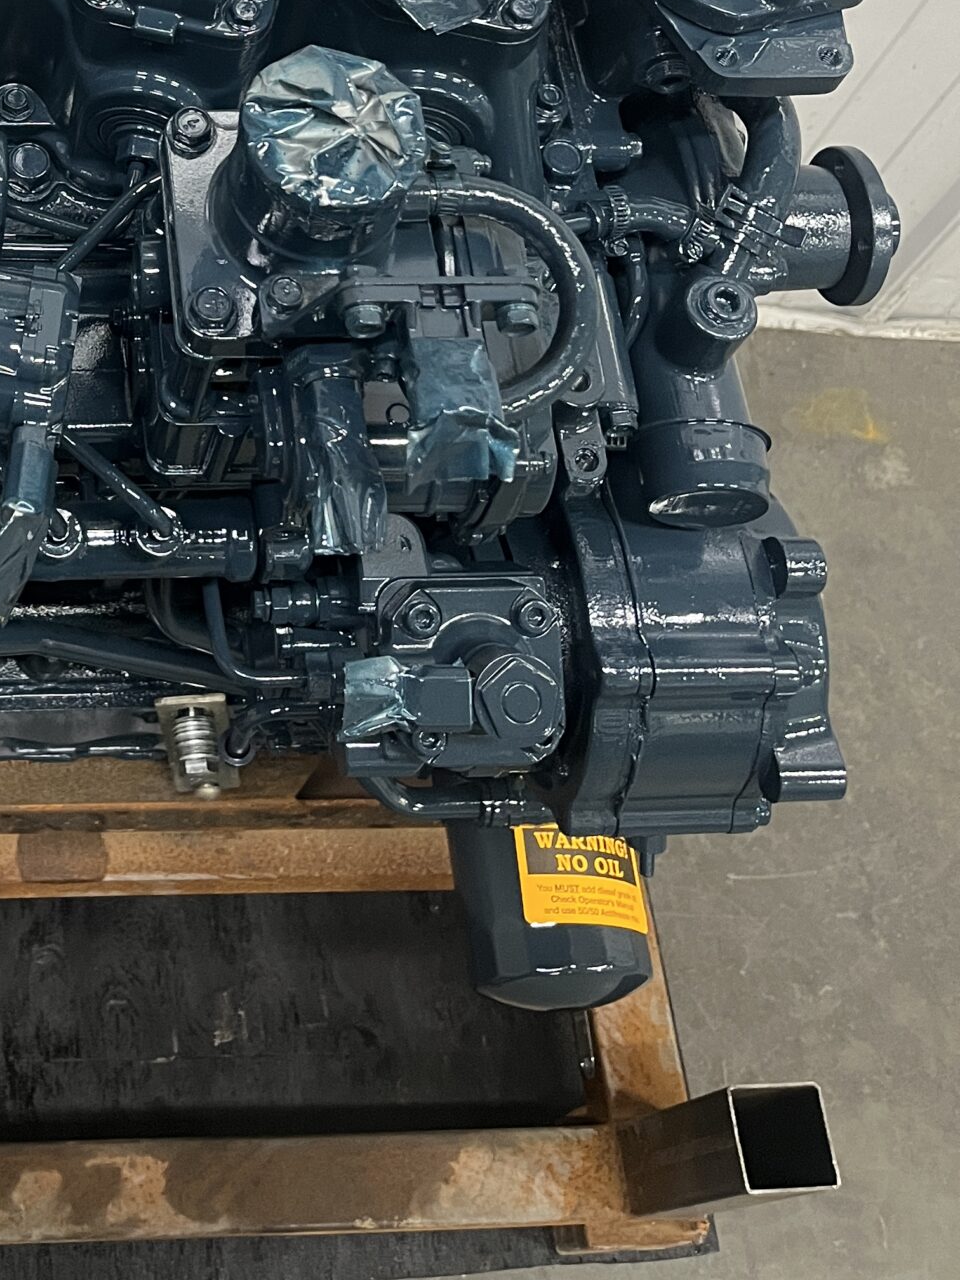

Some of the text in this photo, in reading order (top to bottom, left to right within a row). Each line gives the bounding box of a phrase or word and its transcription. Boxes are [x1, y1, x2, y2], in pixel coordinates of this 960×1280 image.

[533, 831, 628, 859] WARNING!
[555, 853, 625, 878] NO OIL
[555, 884, 579, 894] MUST
